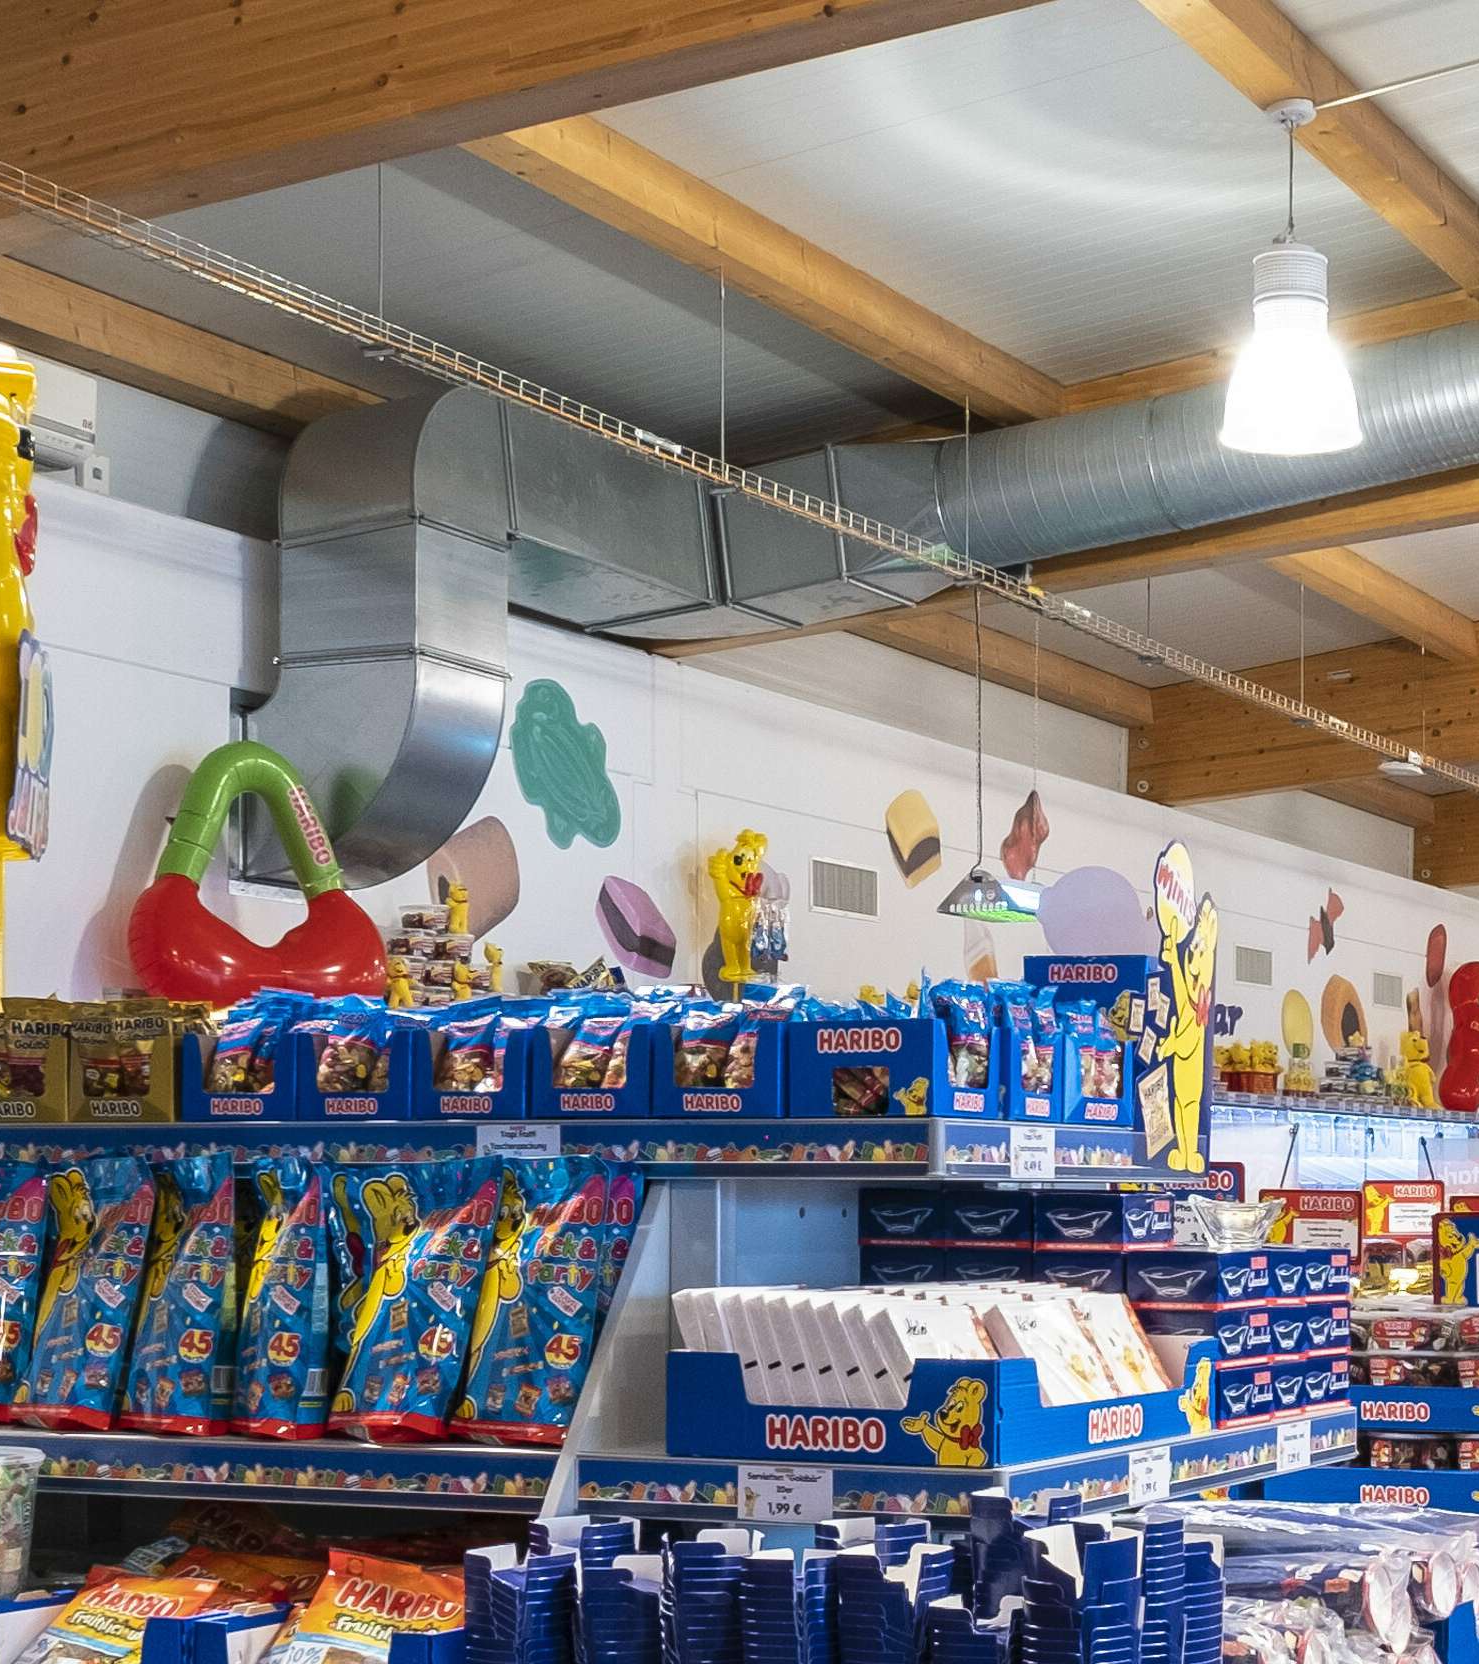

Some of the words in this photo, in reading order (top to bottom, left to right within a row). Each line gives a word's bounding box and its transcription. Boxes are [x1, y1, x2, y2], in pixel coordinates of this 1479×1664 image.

[1048, 964, 1117, 983] HARIBO
[11, 1019, 70, 1036] HARIBO
[817, 1027, 901, 1055] HARIBO
[209, 1098, 264, 1115] HARIBO
[325, 1097, 378, 1115] HARIBO
[953, 1093, 984, 1113] HARIBO
[1084, 1101, 1118, 1121] HARIBO
[1393, 1186, 1436, 1198] HARIBO
[1300, 1197, 1354, 1211] HARIBO
[269, 1333, 301, 1362] 45
[546, 1333, 581, 1362] 45
[1360, 1401, 1431, 1423] HARIBO
[767, 1415, 886, 1451] HARIBO
[1088, 1404, 1144, 1444] HARIBO
[767, 1502, 790, 1515] 1,99
[793, 1503, 802, 1515] €
[336, 1576, 461, 1620] HARIBO
